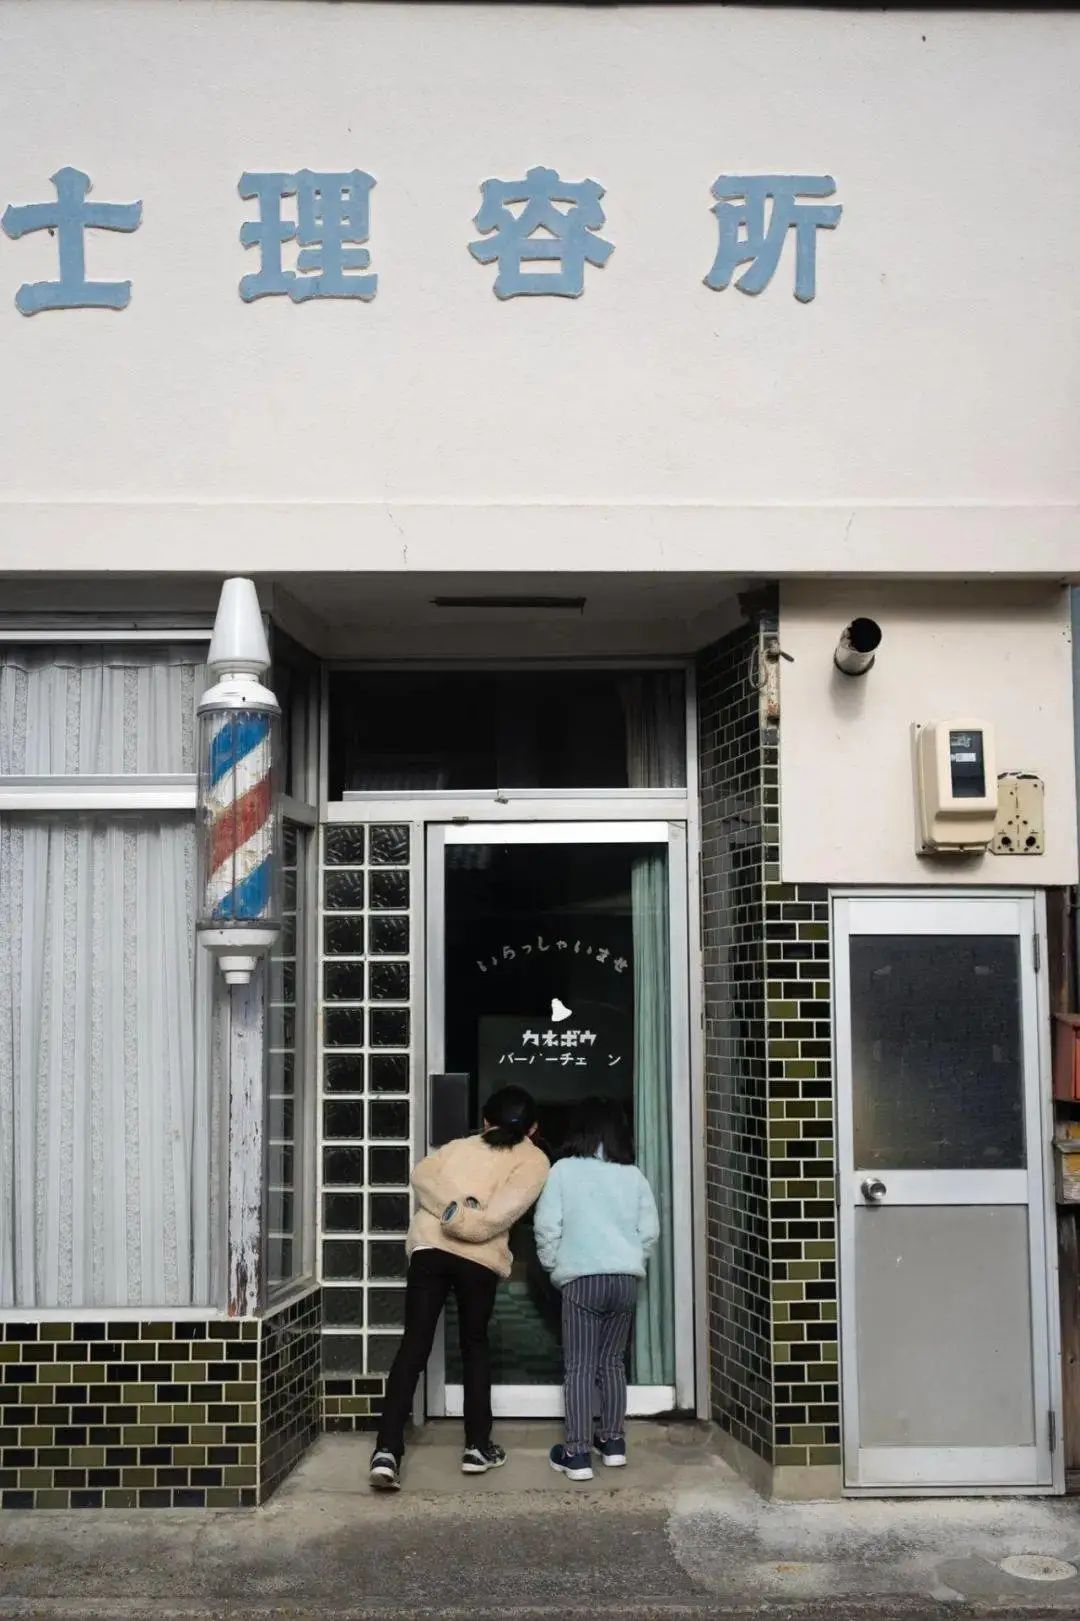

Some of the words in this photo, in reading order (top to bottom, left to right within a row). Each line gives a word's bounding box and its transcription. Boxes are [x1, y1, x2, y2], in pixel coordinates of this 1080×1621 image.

[1, 166, 843, 317] 士理容所
[476, 936, 629, 973] いらっしゃいませ
[522, 1029, 597, 1048] カネボウ
[498, 1051, 622, 1067] バーーチェン
